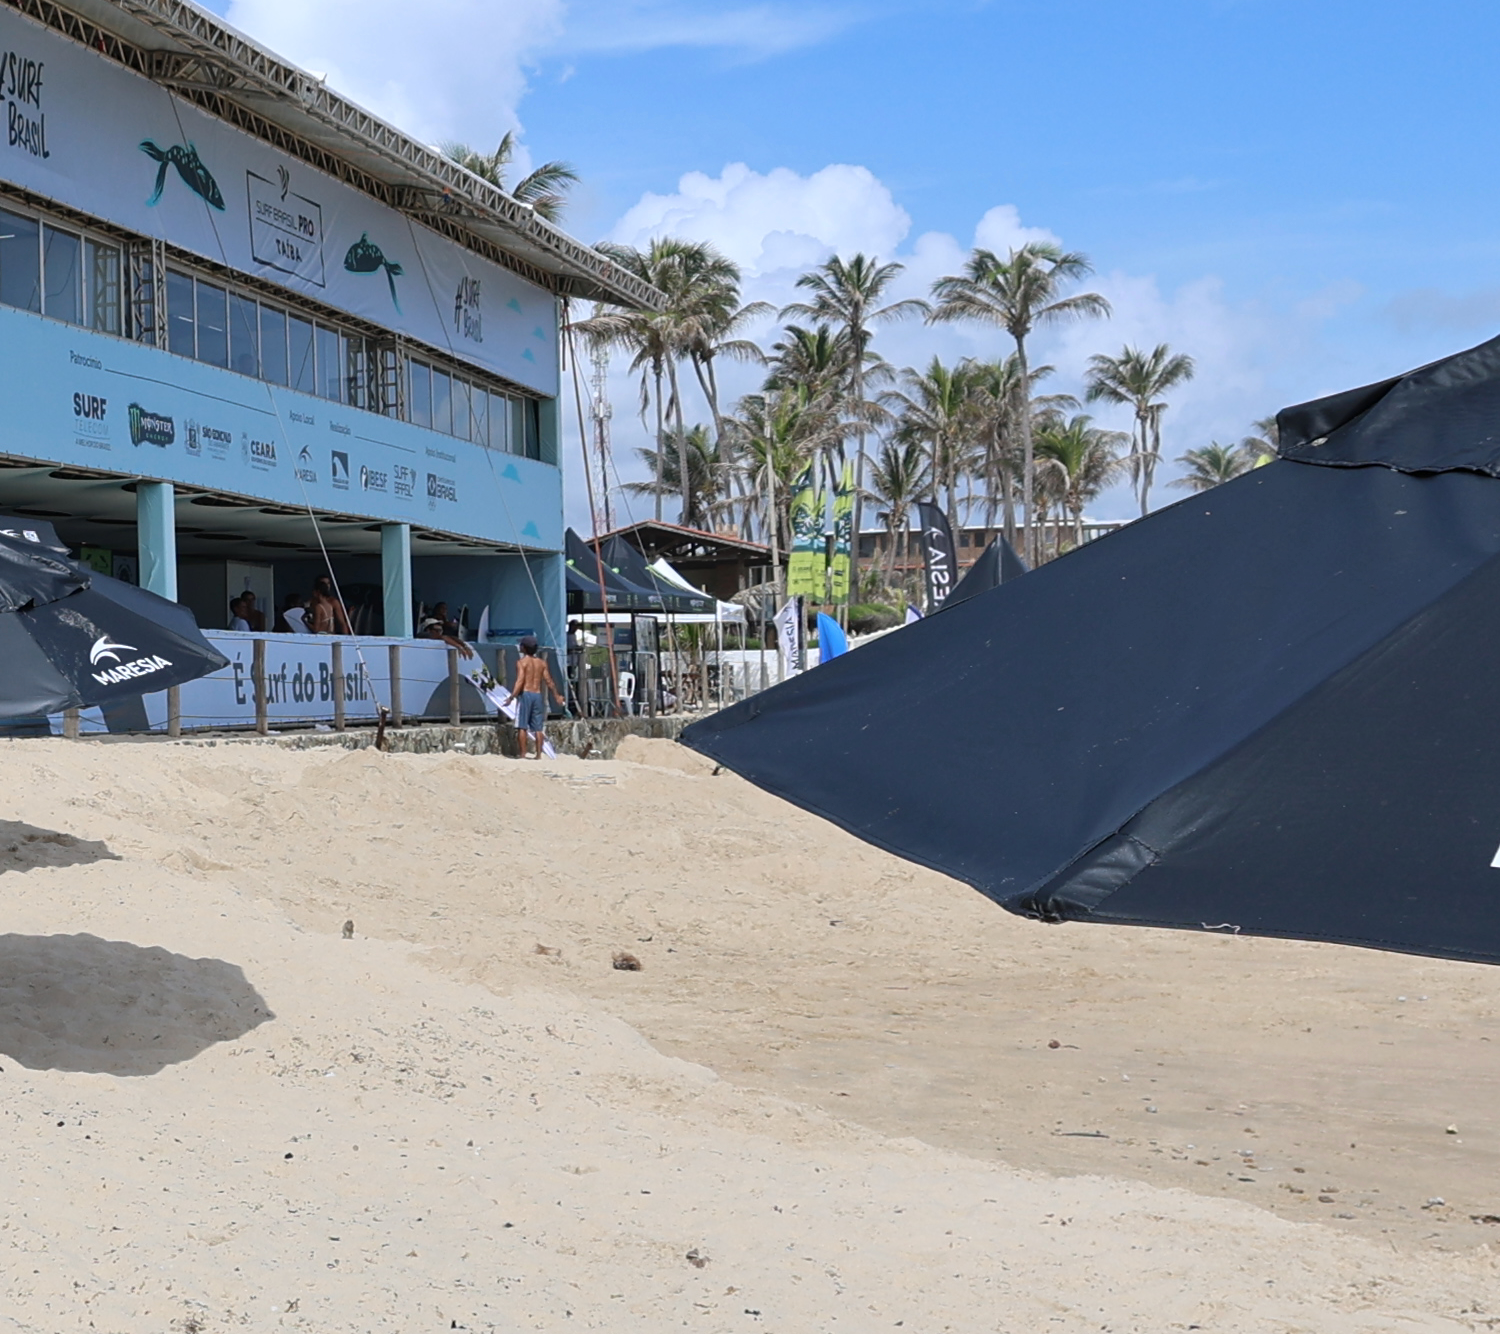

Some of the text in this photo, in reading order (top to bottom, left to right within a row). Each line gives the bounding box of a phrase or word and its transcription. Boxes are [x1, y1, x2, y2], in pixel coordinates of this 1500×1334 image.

[8, 101, 50, 159] BRASIL
[298, 214, 315, 237] PRO
[73, 392, 106, 421] SURF
[141, 416, 172, 434] MONSTER
[251, 441, 276, 460] CEARÁ
[436, 484, 457, 502] BRASIL
[92, 654, 173, 686] MARESIA
[233, 652, 246, 704] É
[293, 662, 315, 702] do
